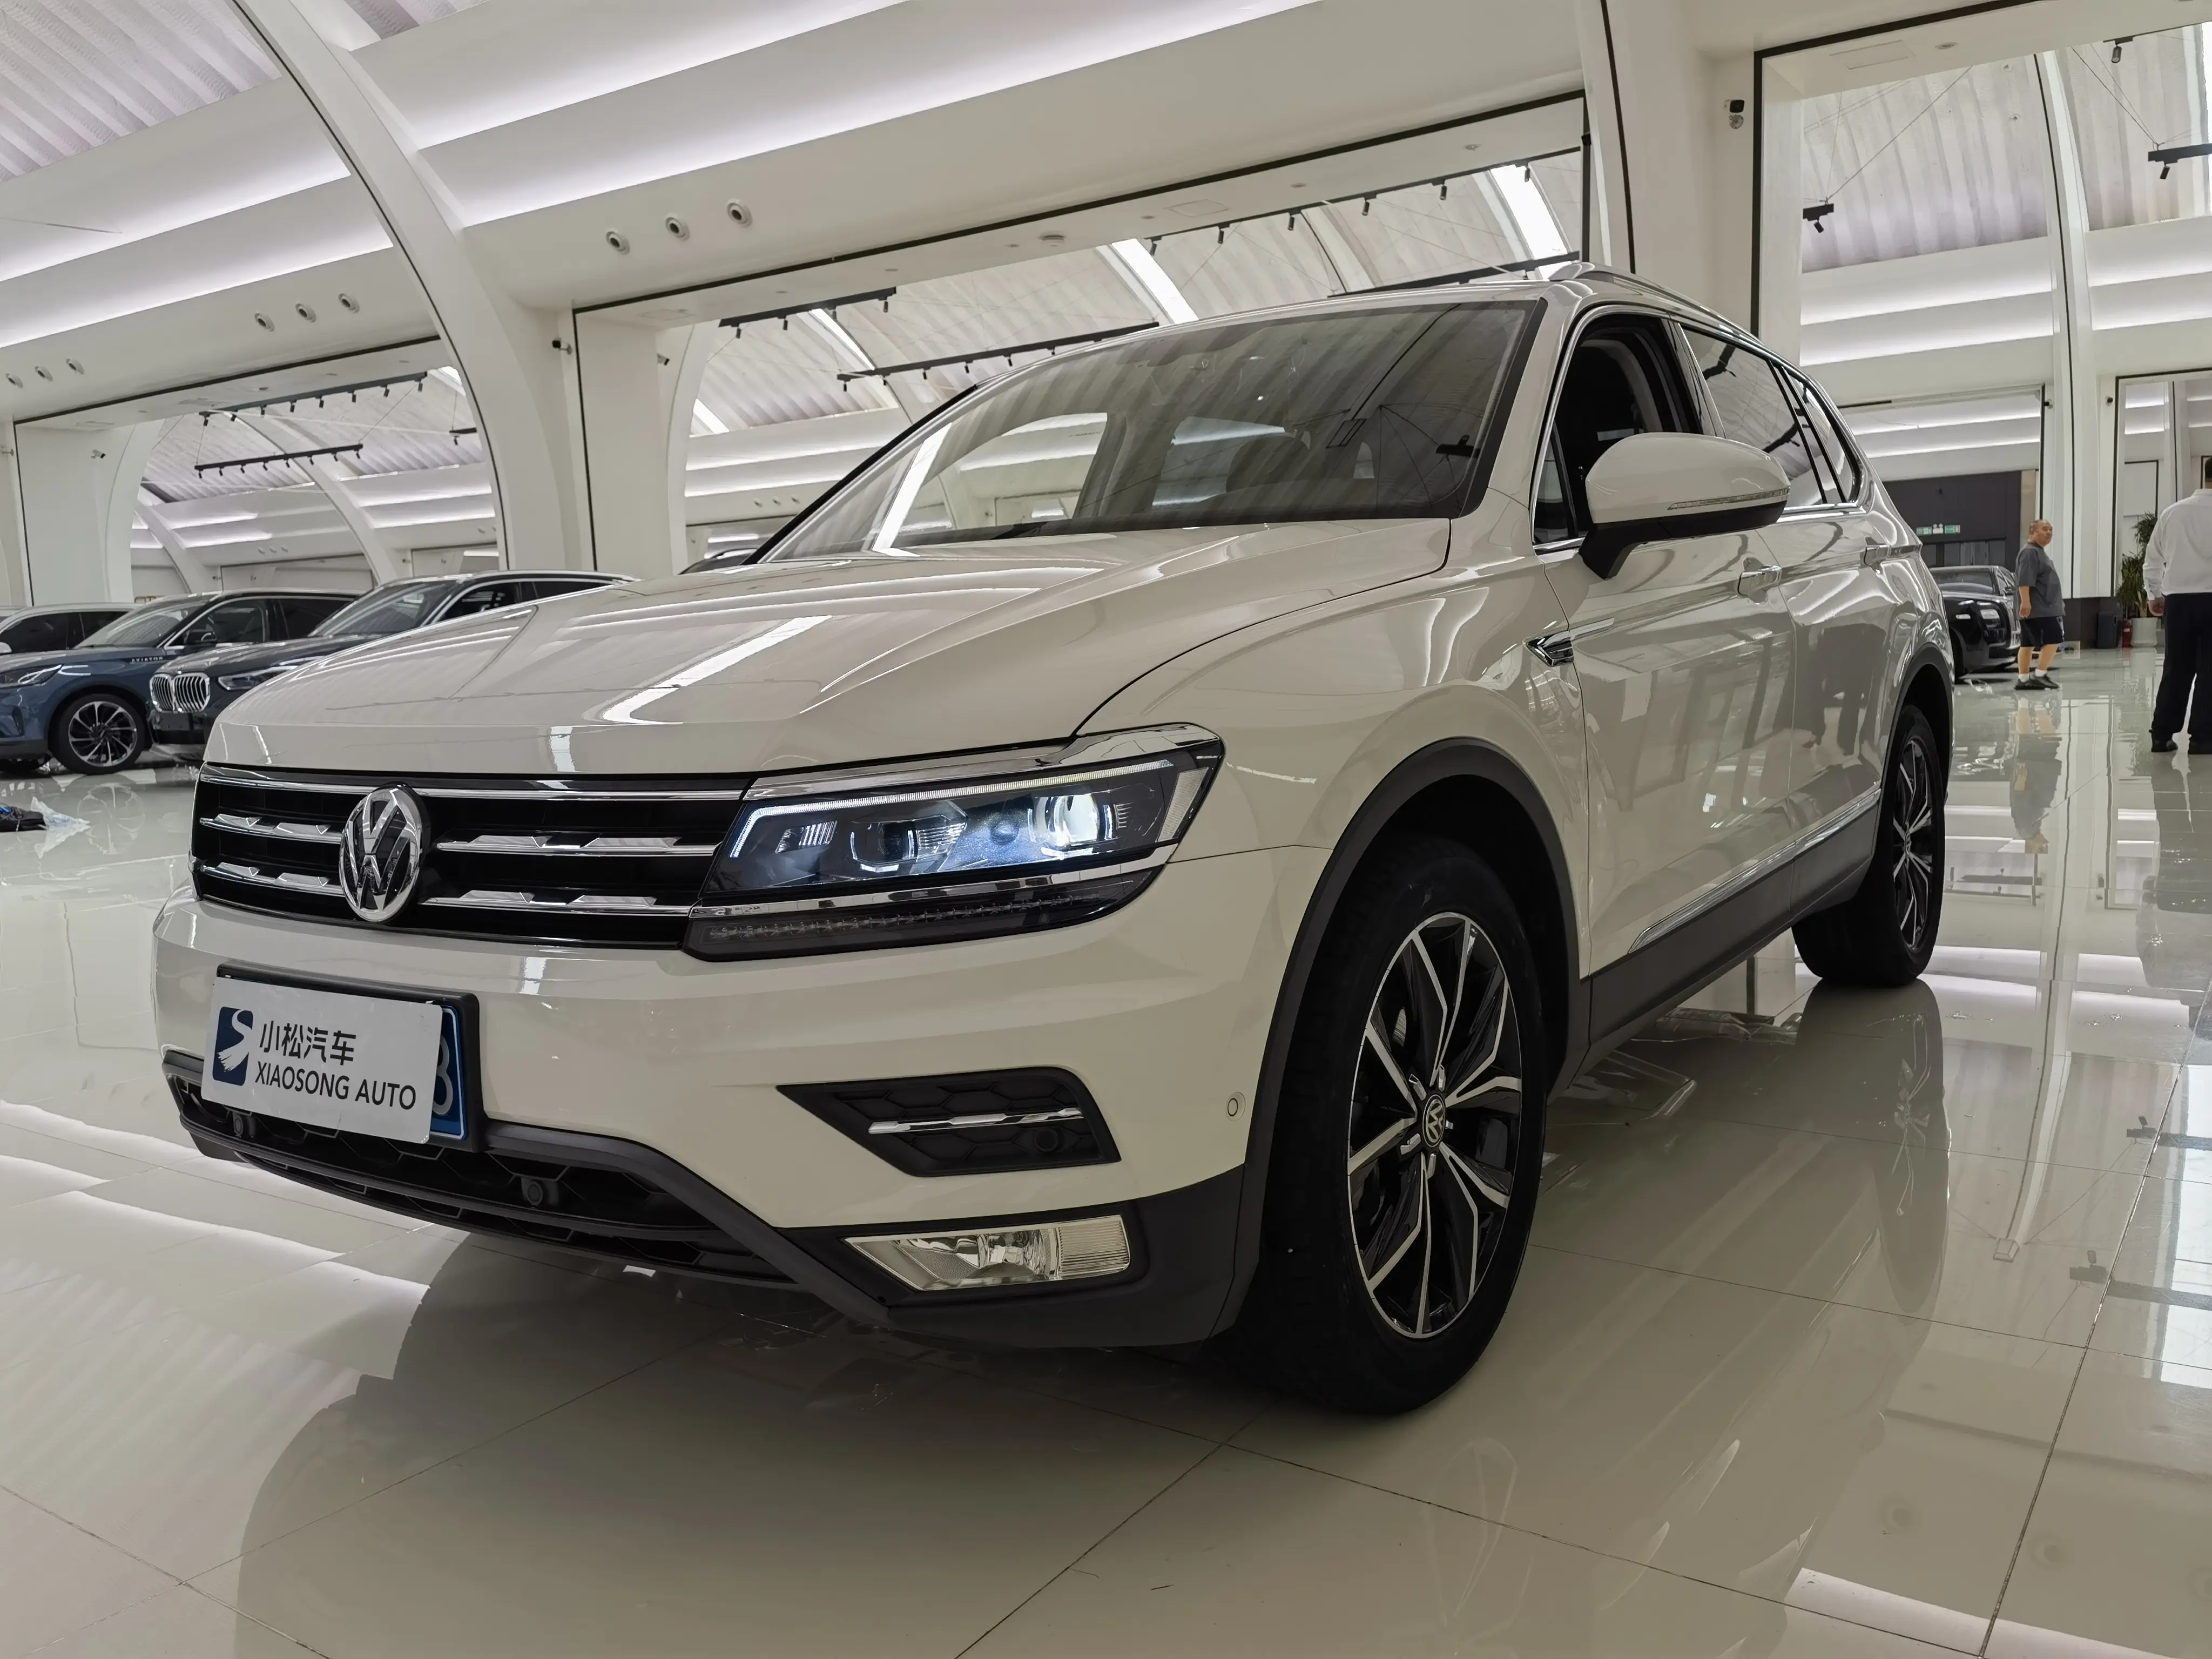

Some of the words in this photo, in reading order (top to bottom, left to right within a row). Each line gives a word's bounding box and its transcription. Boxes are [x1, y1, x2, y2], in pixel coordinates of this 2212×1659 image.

[259, 1020, 356, 1066] 小松汽车
[254, 1061, 350, 1100] XIAOSONG
[354, 1078, 416, 1110] AUTO
